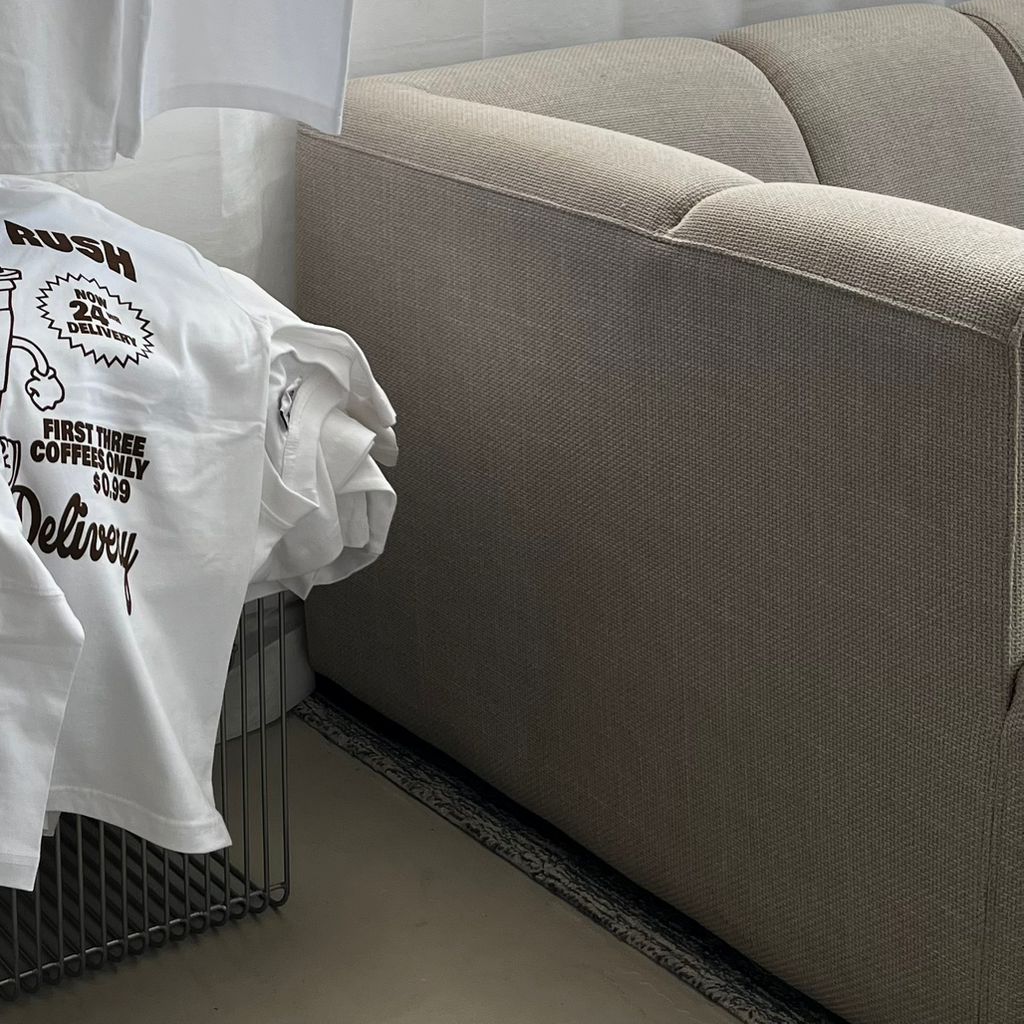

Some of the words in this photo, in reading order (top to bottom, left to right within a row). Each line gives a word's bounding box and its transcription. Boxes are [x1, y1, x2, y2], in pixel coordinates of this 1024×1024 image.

[4, 220, 137, 283] RUSH
[69, 301, 109, 326] 24
[74, 289, 107, 309] NOW
[67, 322, 137, 347] DELIVERY
[43, 418, 94, 445] FIRST
[95, 426, 147, 458] THREE
[30, 440, 105, 470] COFFEES
[106, 451, 150, 481] ONLY
[93, 472, 130, 504] $0.99
